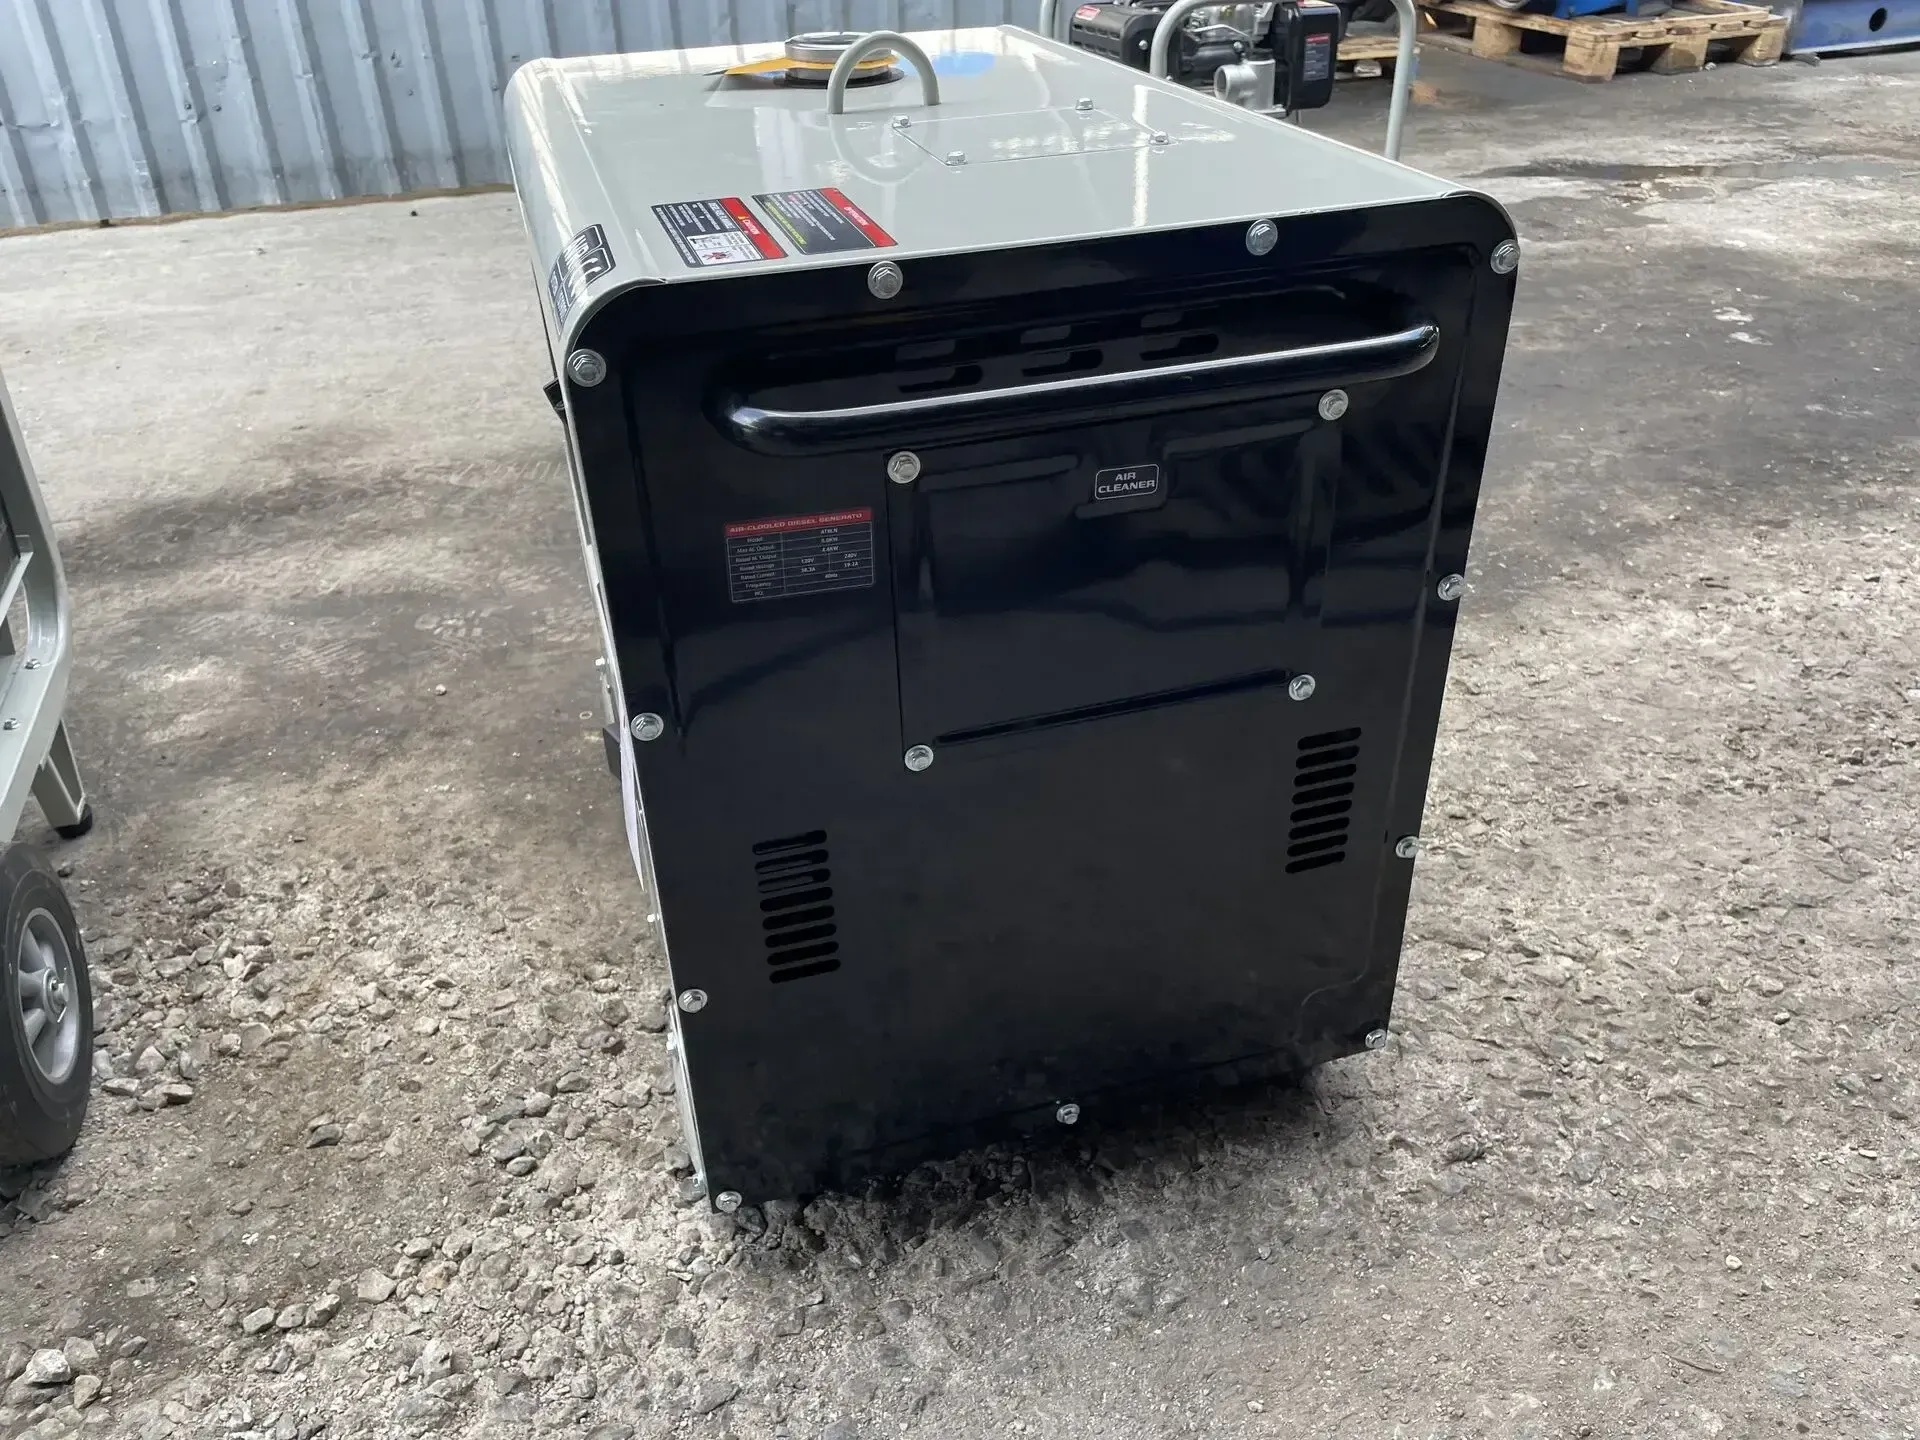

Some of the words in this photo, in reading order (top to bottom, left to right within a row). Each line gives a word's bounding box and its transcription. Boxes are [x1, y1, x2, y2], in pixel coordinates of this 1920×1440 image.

[1115, 471, 1136, 481] AIR
[1098, 479, 1155, 493] CLEANER
[787, 517, 817, 527] DIESEL
